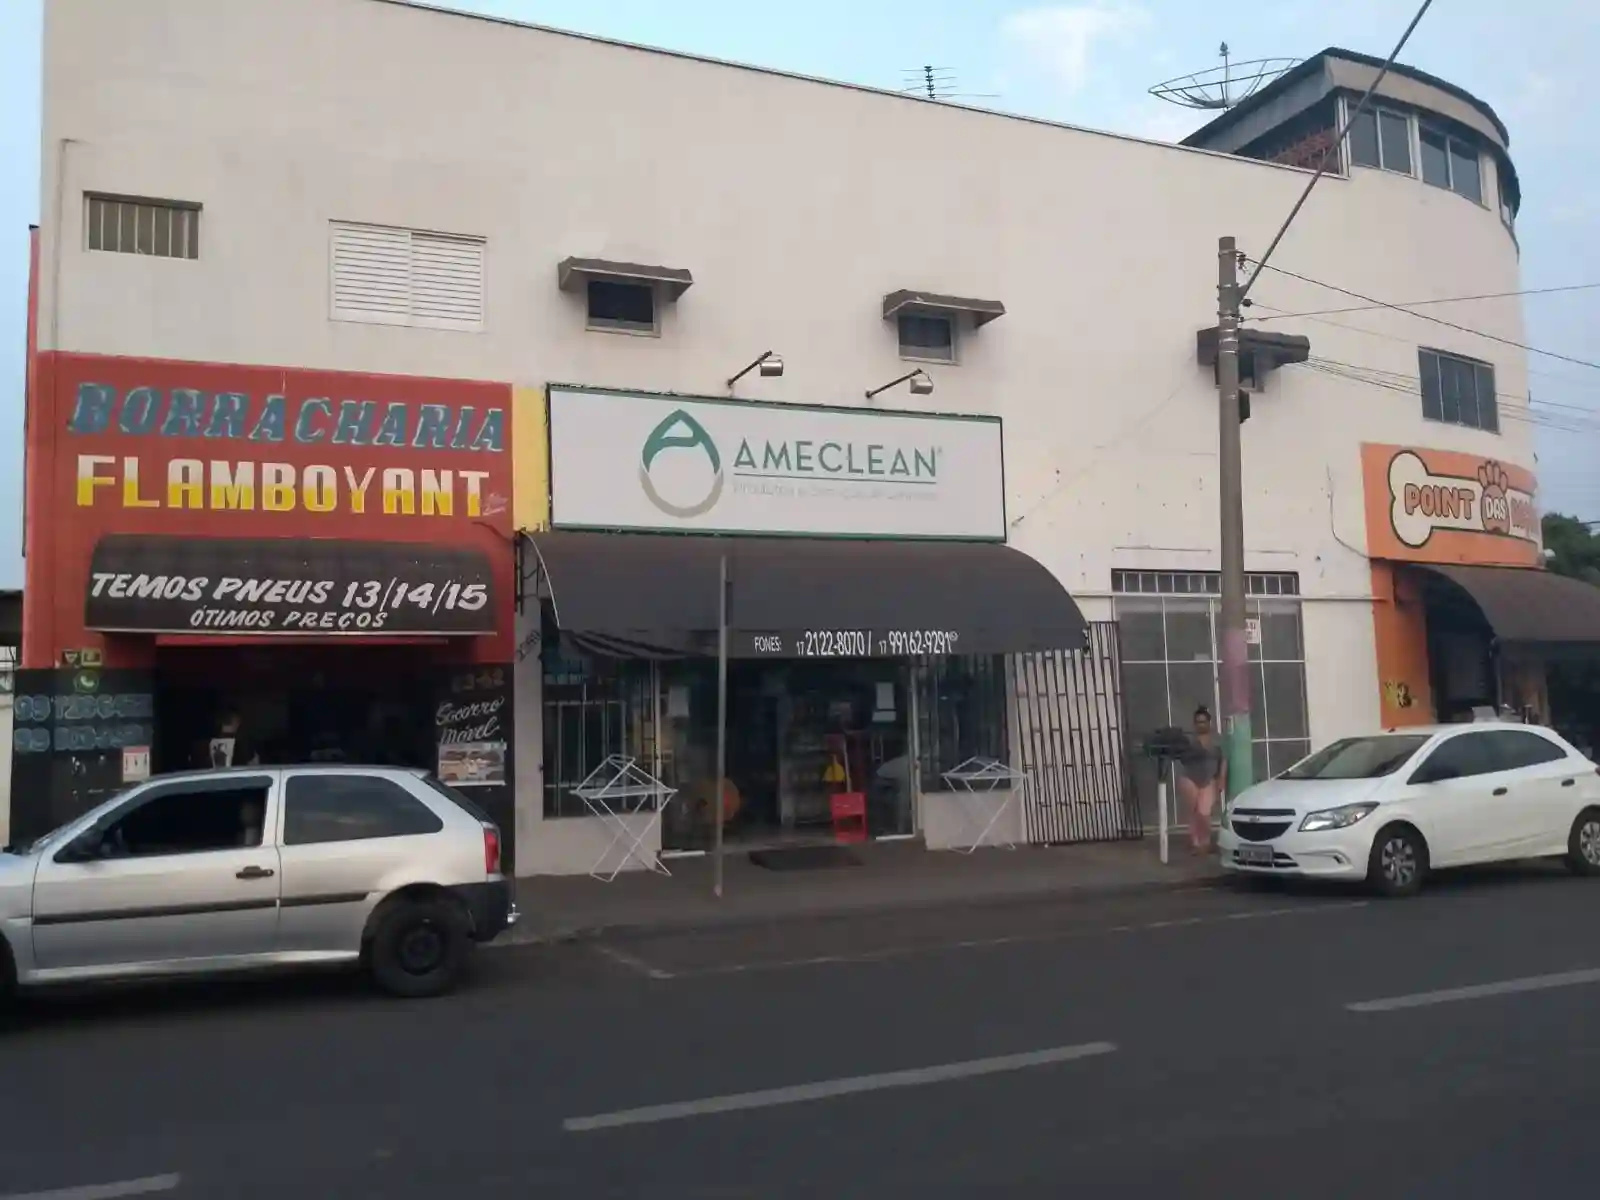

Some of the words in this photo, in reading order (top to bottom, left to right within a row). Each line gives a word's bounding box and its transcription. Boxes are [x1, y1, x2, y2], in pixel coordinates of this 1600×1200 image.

[69, 382, 505, 453] BORRACHARIA
[733, 438, 936, 477] AMECLEAN
[76, 454, 490, 518] FLAMBOYANT
[1404, 483, 1475, 520] POINT
[1485, 496, 1507, 521] DAS
[91, 573, 207, 600] TEMOS
[212, 578, 334, 604] PNEUS
[341, 577, 489, 615] 13/14/15
[190, 605, 274, 628] ÓTIMOS
[282, 610, 388, 630] PREÇOS
[754, 636, 782, 652] FONES:
[805, 630, 865, 656] 2122-8070
[888, 630, 952, 656] 99162-9291
